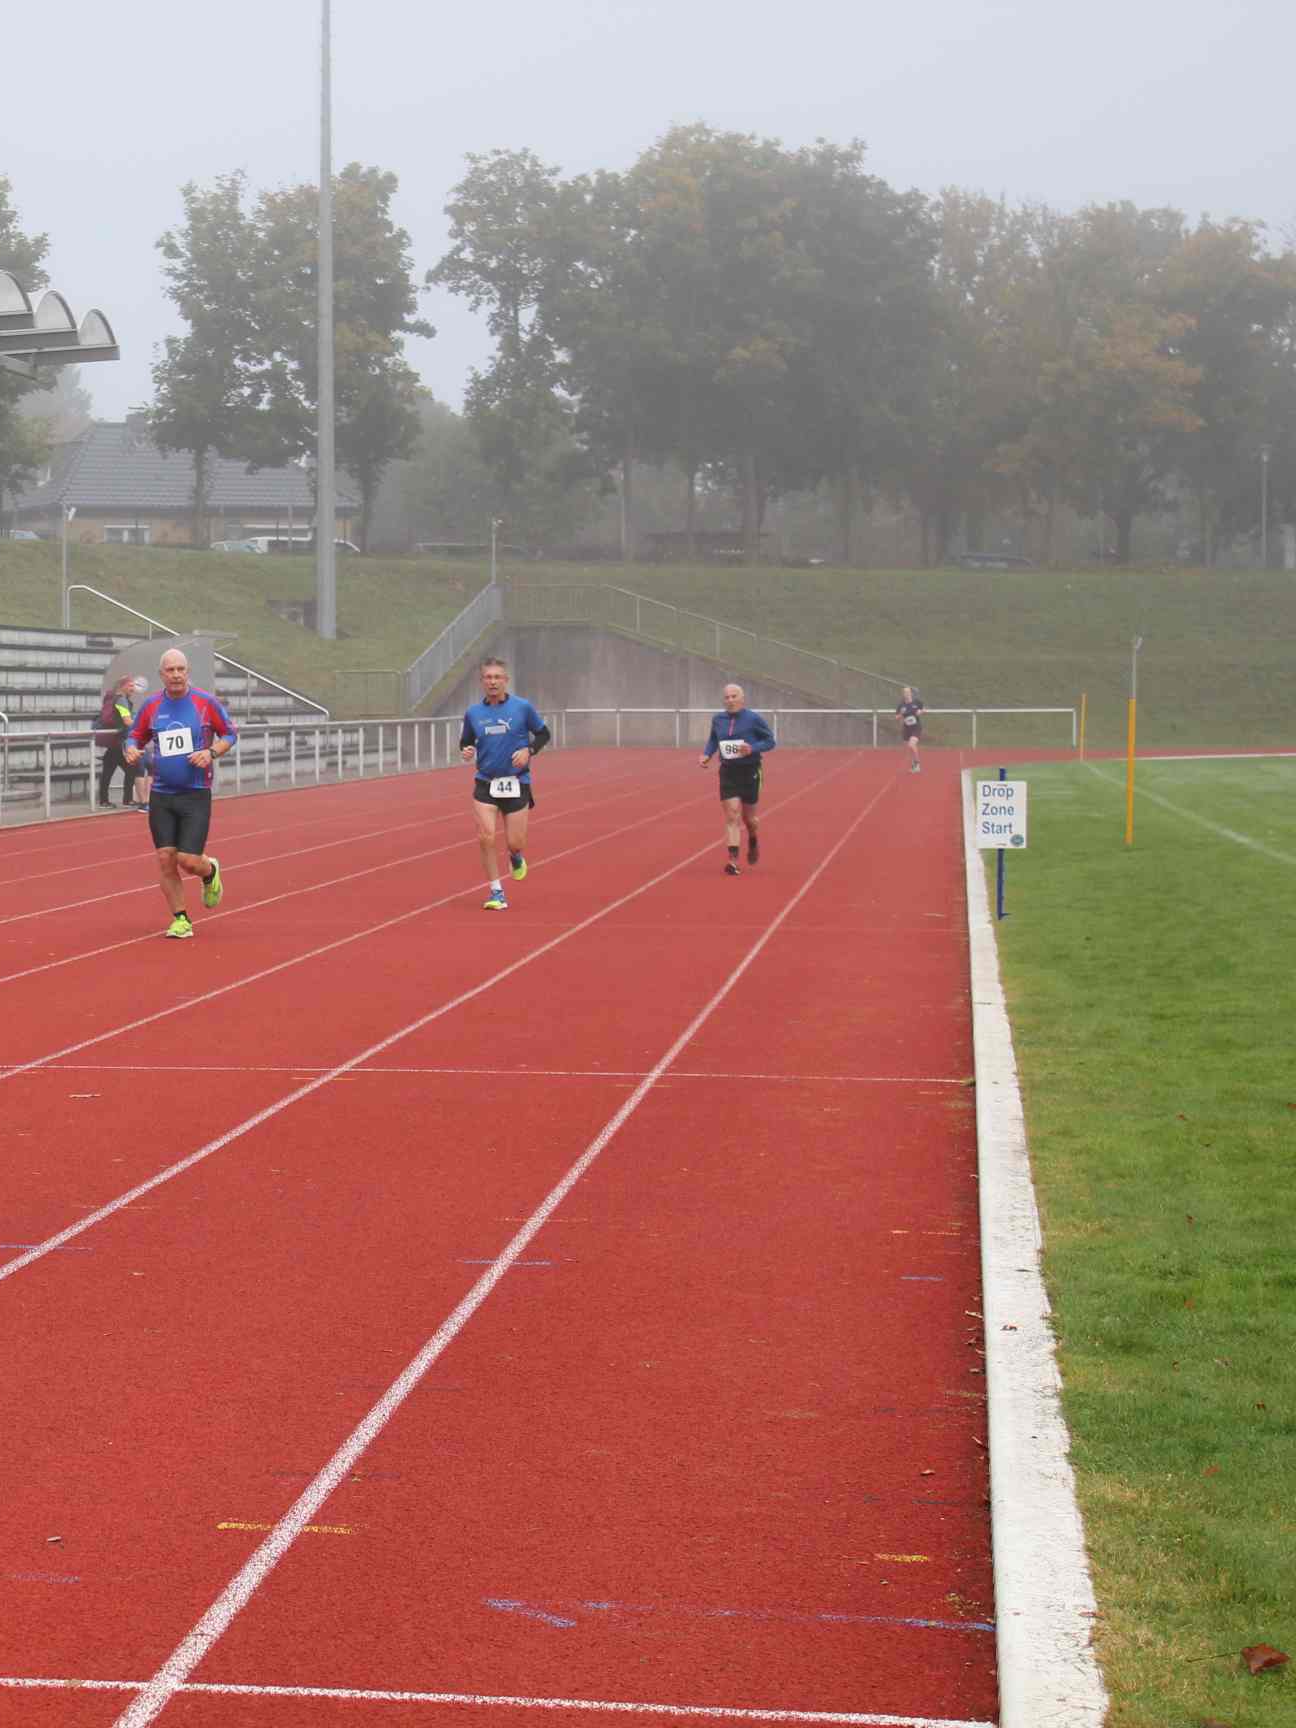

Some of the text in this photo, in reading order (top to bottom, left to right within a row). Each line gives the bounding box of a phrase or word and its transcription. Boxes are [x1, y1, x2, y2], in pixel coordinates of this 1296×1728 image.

[166, 735, 184, 750] 70
[497, 781, 512, 792] 44
[982, 784, 1014, 800] Drop
[982, 803, 1014, 816] Zone
[982, 821, 1013, 834] Start
